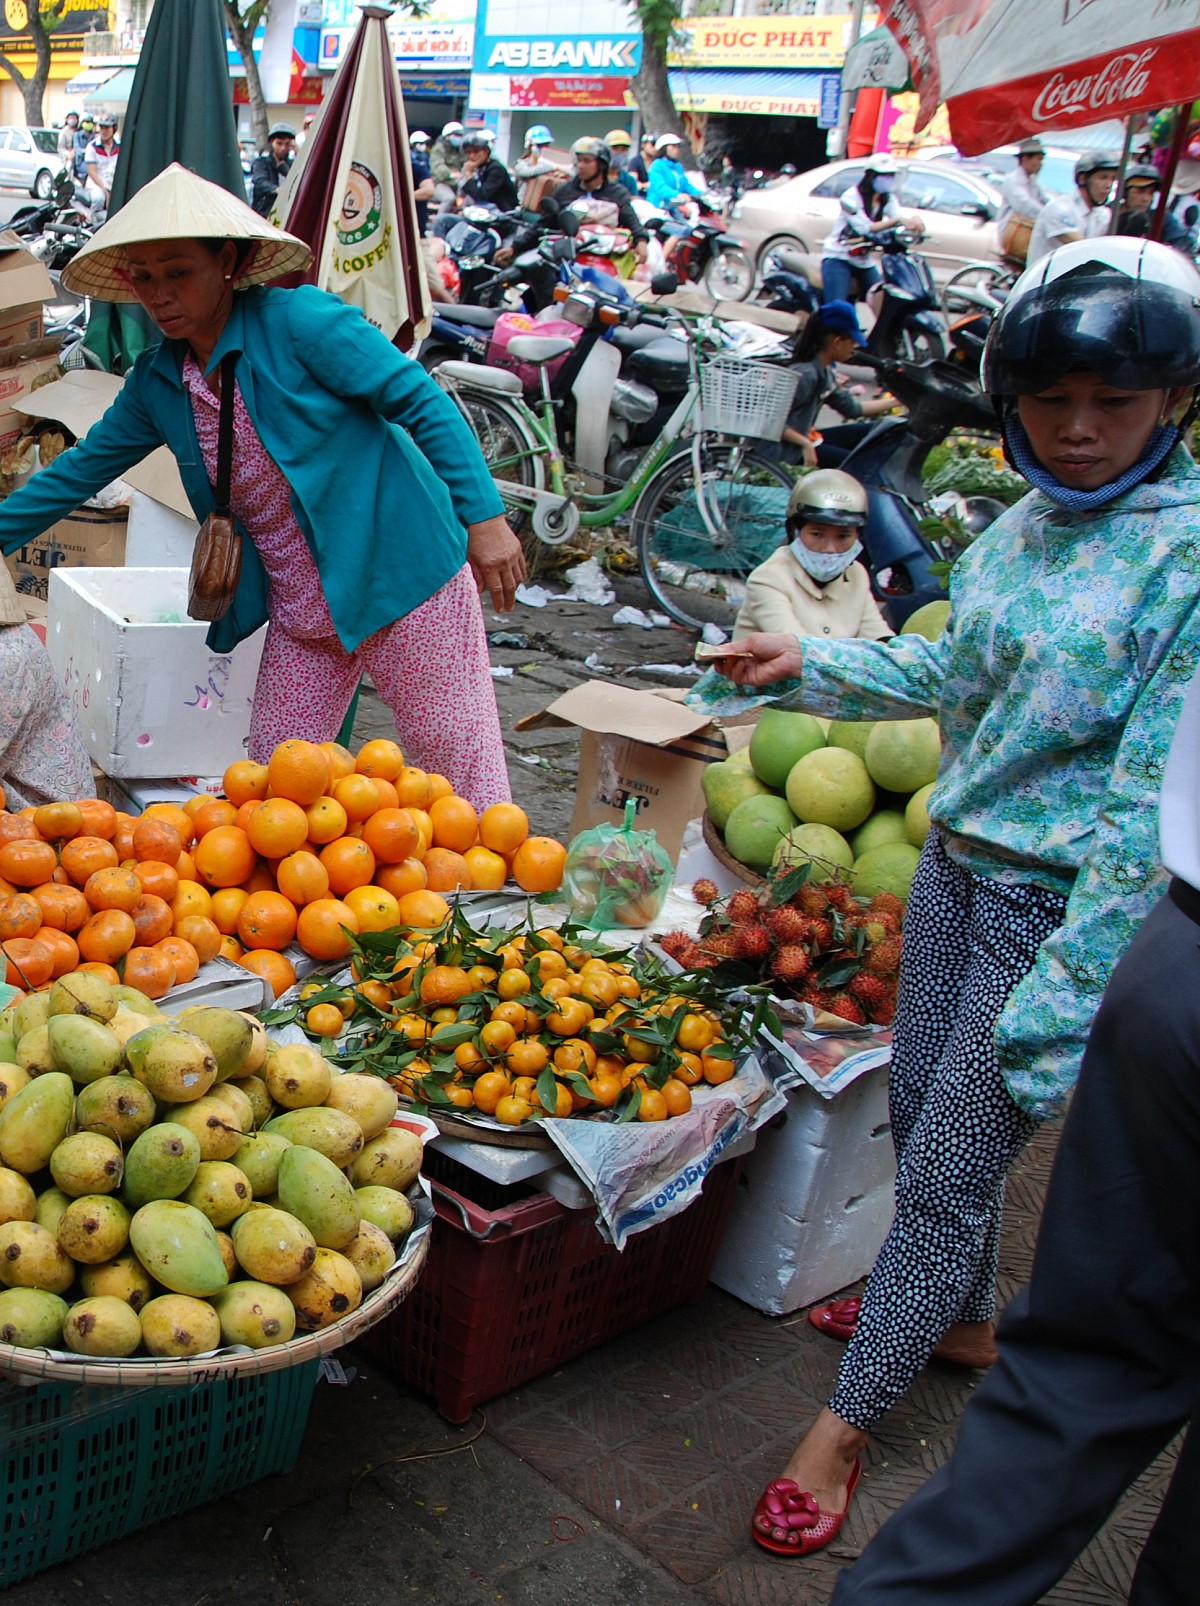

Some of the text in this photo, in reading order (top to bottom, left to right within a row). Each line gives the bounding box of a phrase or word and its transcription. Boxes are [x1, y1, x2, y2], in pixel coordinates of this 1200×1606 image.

[704, 26, 832, 47] ĐỨC PHÁT
[487, 40, 638, 68] ABBANK
[1032, 46, 1160, 121] Coca-Cola
[16, 546, 66, 568] JET
